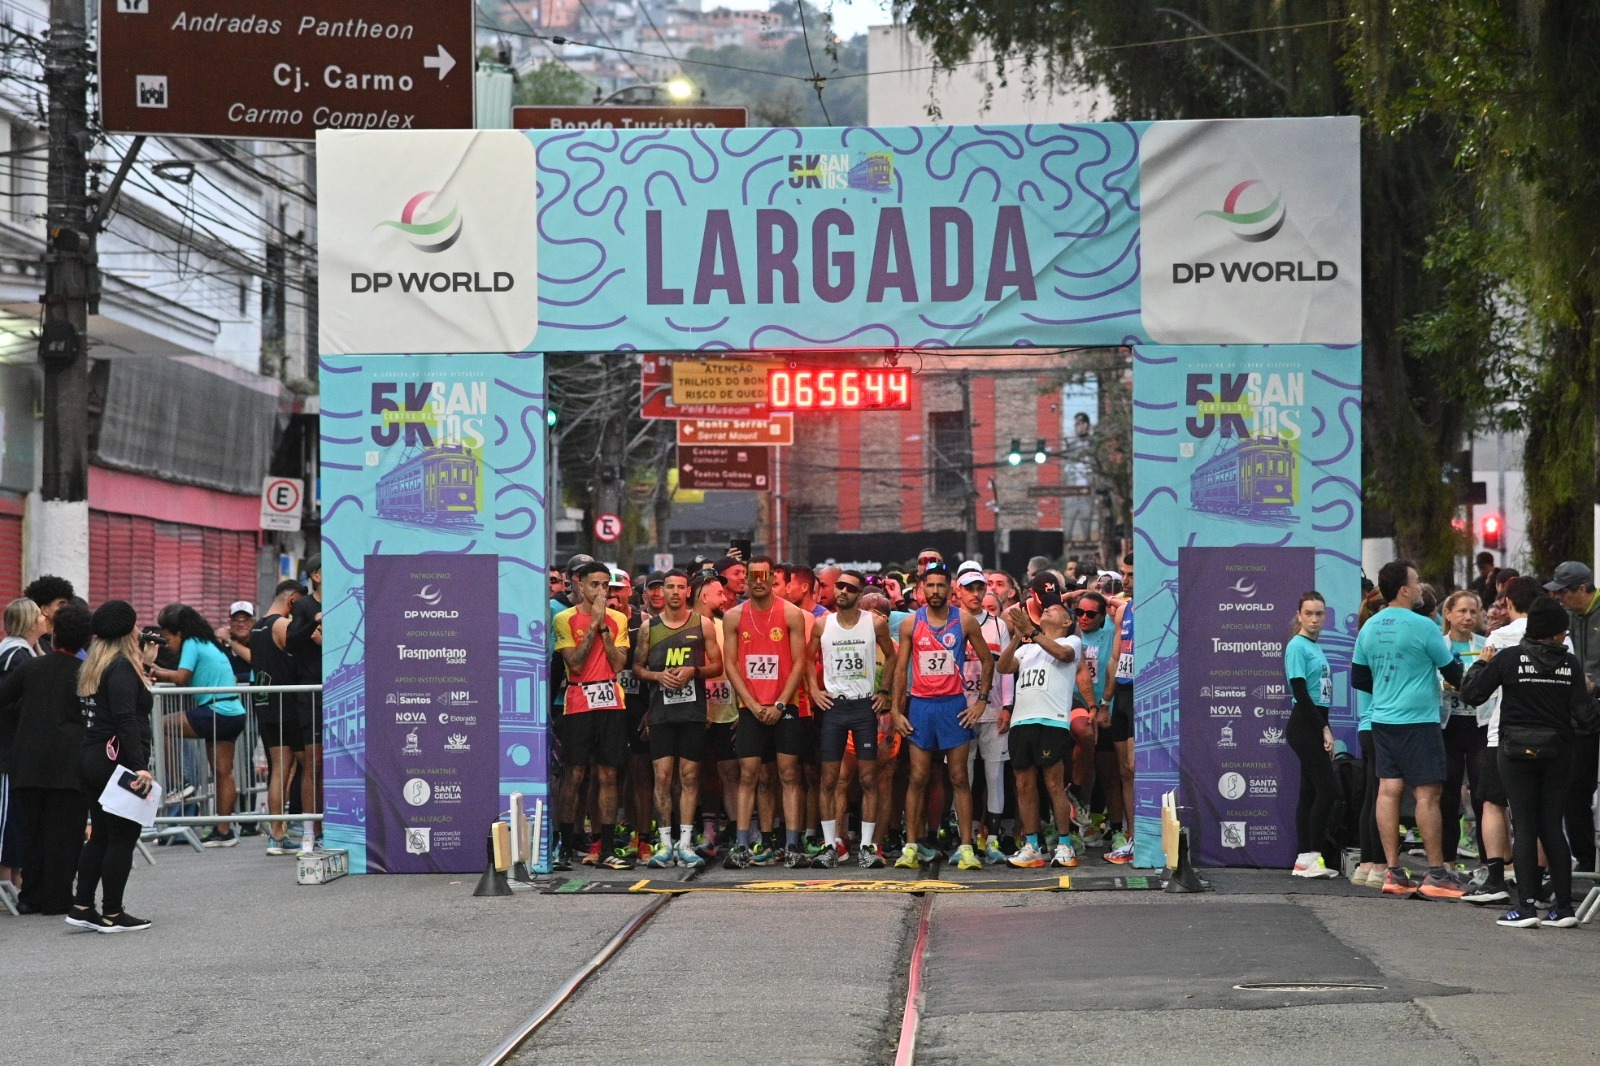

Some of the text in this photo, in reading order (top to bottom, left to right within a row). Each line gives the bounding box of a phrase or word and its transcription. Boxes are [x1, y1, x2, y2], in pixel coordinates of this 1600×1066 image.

[171, 11, 414, 40] Andradas Pantheon
[273, 62, 414, 93] Cj. Carmo
[227, 103, 415, 129] Carmo Complex
[550, 116, 717, 129] Bonde Turístico
[645, 205, 1038, 305] LARGADA
[1172, 260, 1339, 284] DP WORLD
[351, 271, 515, 293] DP WORLD
[705, 363, 753, 374] ATENÇÃO
[678, 376, 768, 387] TRILHOS DO BON
[685, 388, 768, 399] RISCO DE QUED
[697, 420, 729, 428] Monte
[276, 487, 289, 505] E
[602, 519, 613, 535] E
[1219, 603, 1274, 611] DP WORLD
[404, 610, 459, 618] DP WORLD
[1211, 637, 1282, 653] Trasmontano
[397, 645, 466, 660] Trasmontano
[748, 662, 777, 674] 747
[835, 658, 864, 671] 738
[928, 658, 947, 670] 37
[1118, 660, 1133, 673] 341
[1019, 669, 1046, 688] 1178
[451, 691, 470, 700] NPI
[1214, 690, 1247, 698] Santos
[1266, 685, 1285, 694] NPI
[588, 690, 615, 703] 740
[1210, 705, 1242, 715] NOVA
[396, 712, 426, 722] NOVA
[434, 785, 462, 793] SANTA
[1249, 779, 1277, 787] SANTA
[434, 792, 462, 800] CECÍLIA
[1249, 786, 1278, 794] CECÍLIA
